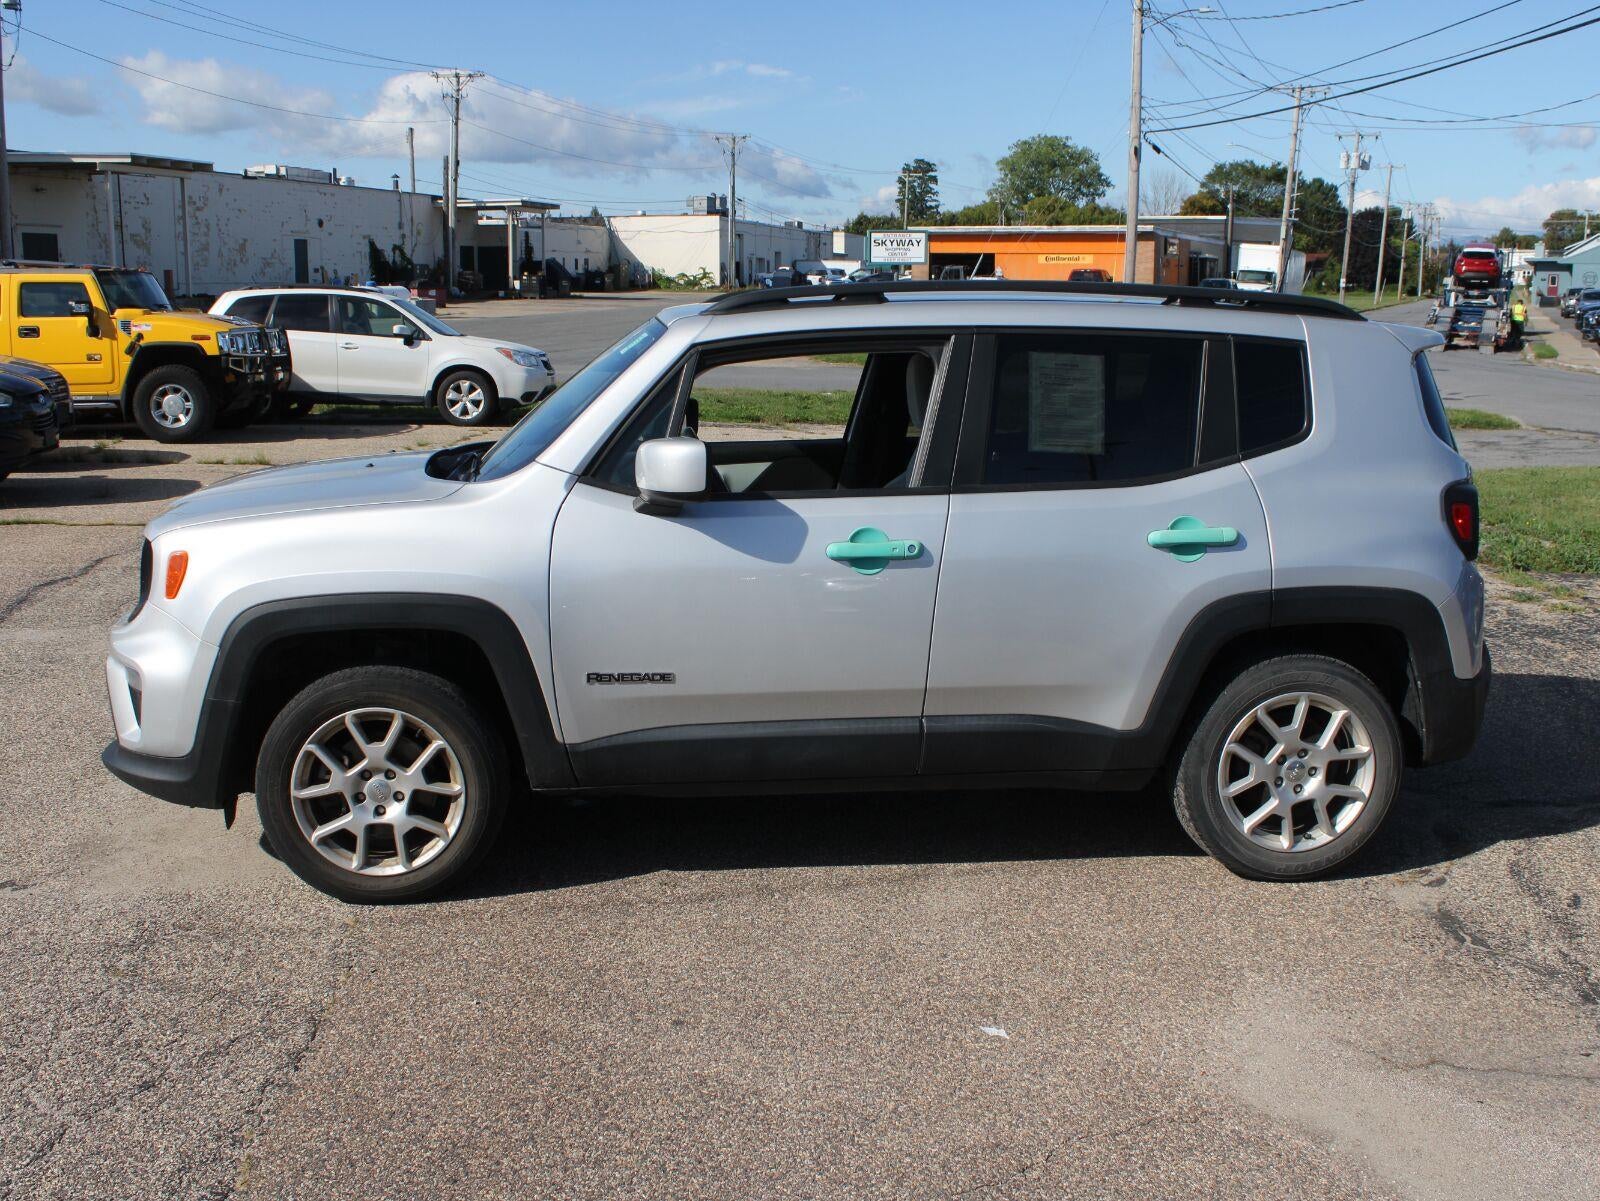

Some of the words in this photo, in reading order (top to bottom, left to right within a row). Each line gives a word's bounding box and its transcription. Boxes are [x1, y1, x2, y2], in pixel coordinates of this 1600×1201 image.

[873, 239, 922, 247] SKYWAY
[1045, 255, 1081, 263] Continental
[586, 672, 675, 684] RENEGADE
